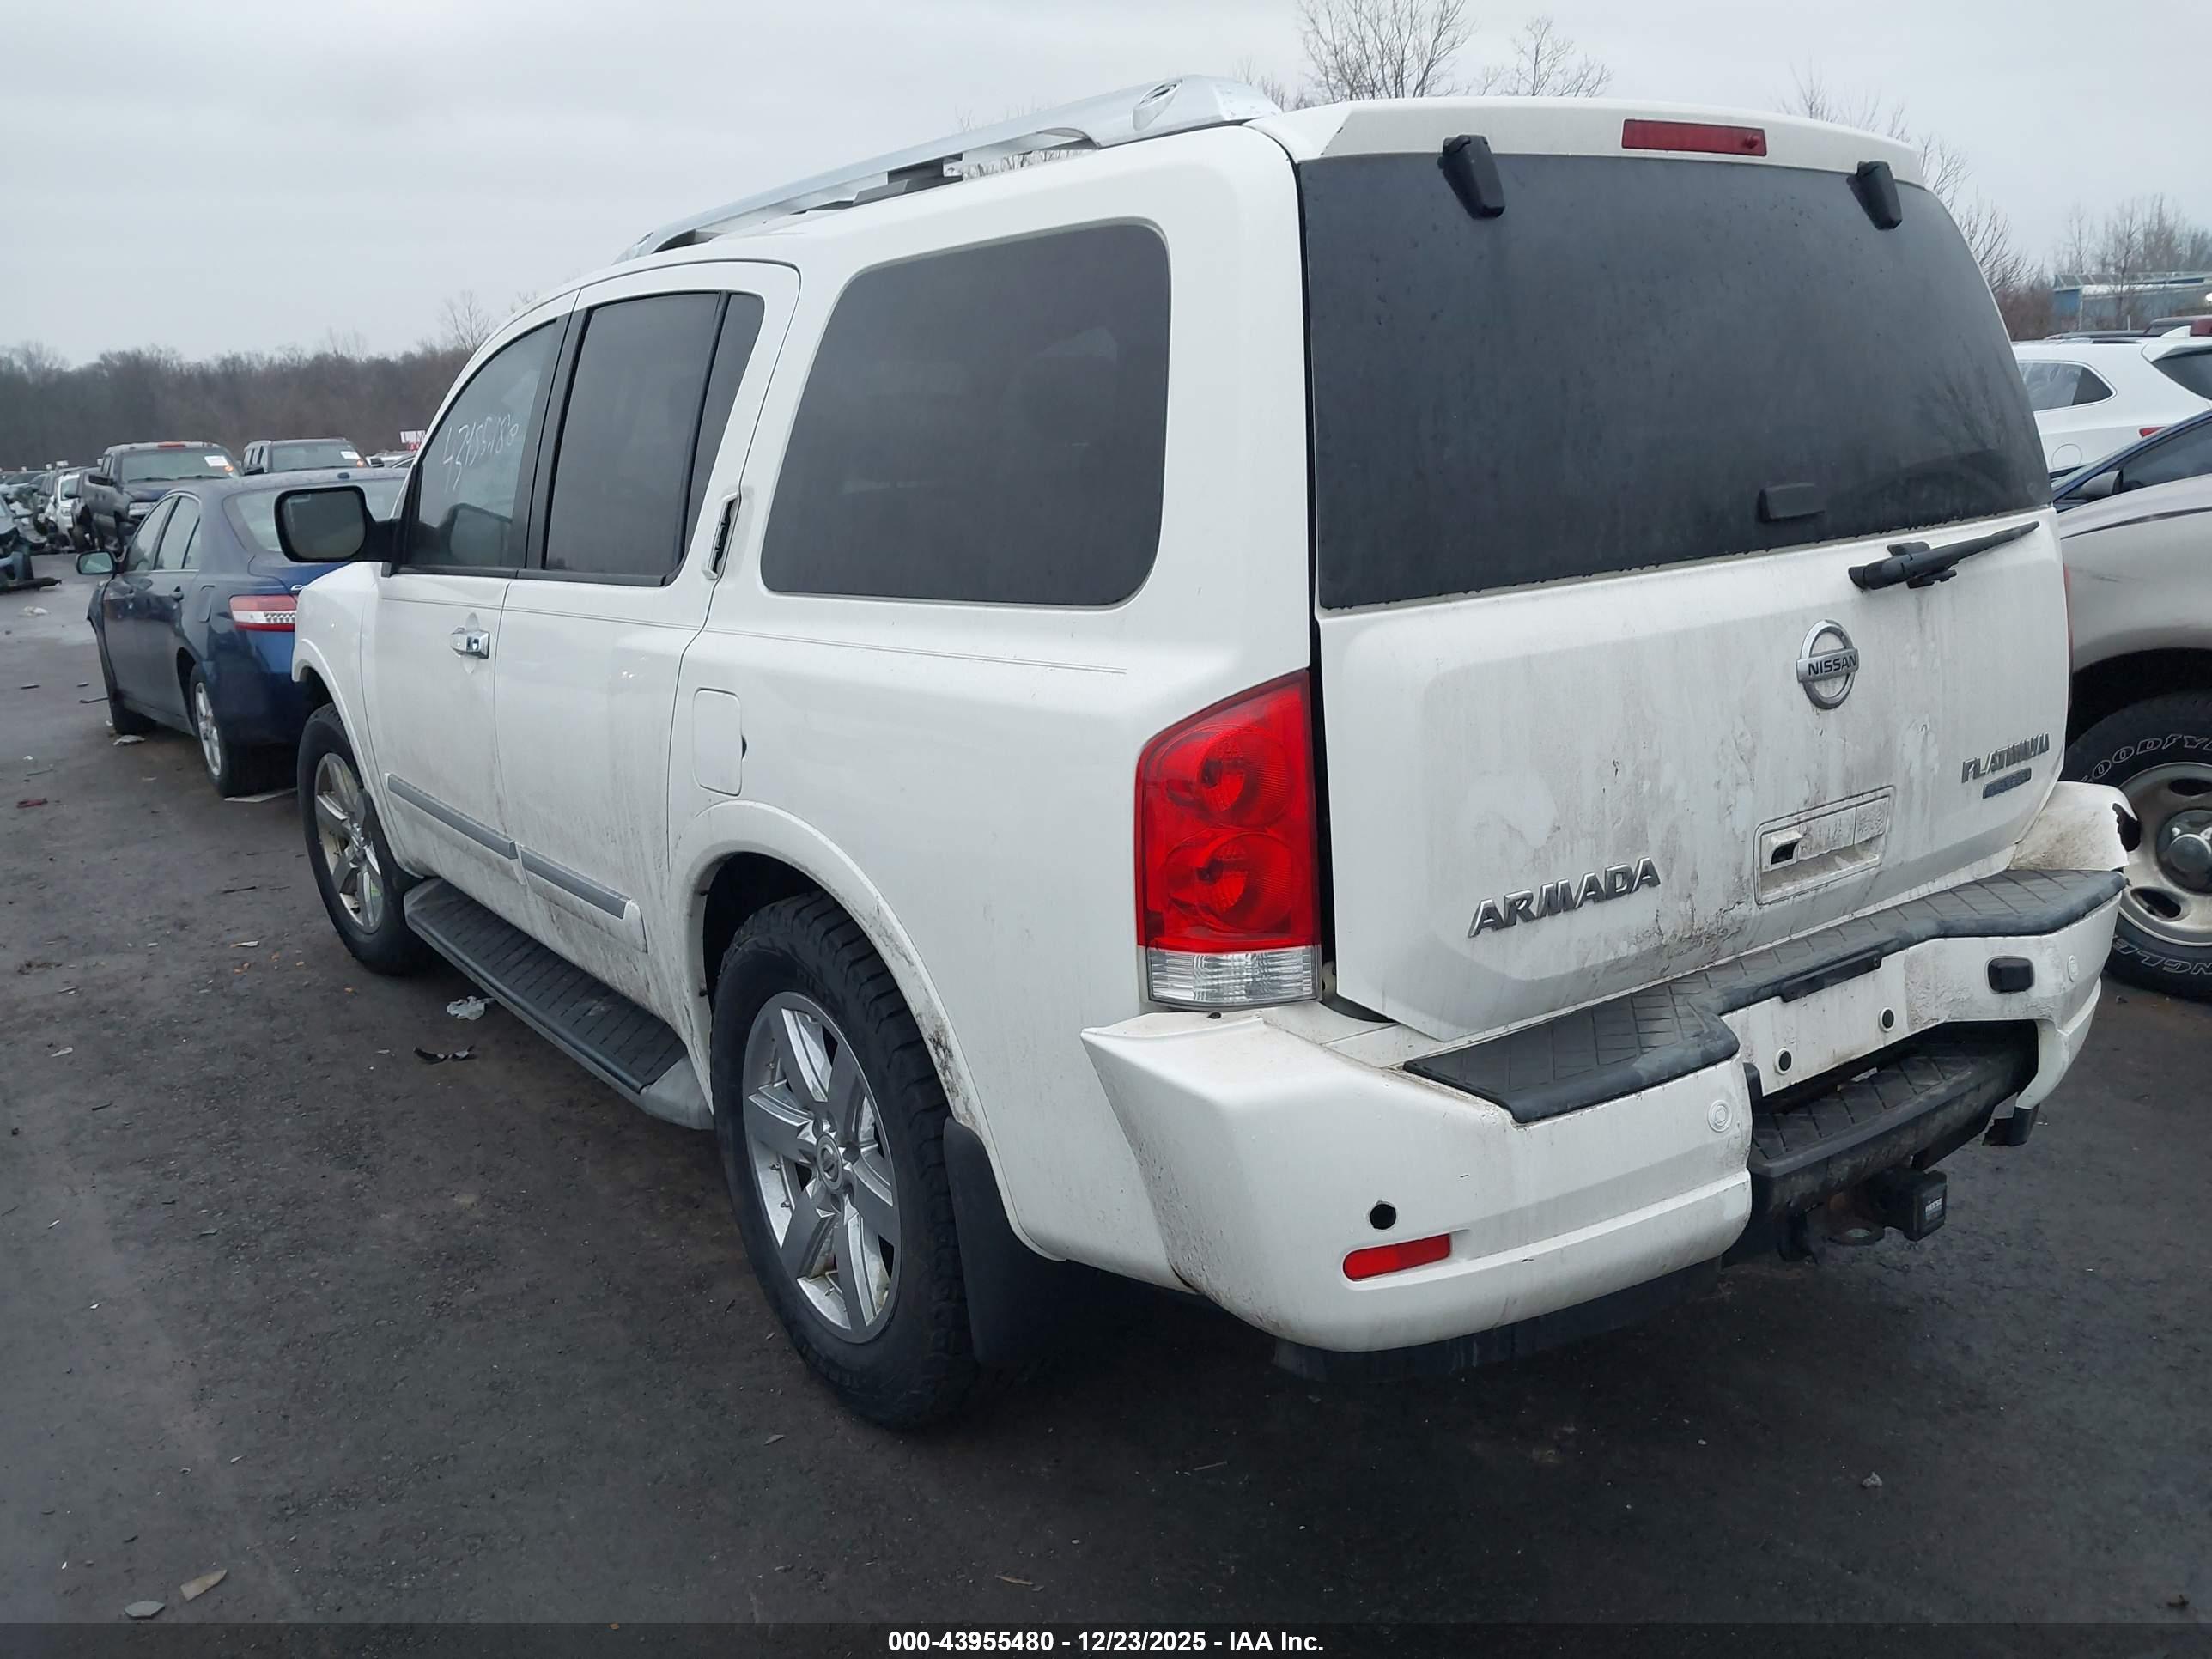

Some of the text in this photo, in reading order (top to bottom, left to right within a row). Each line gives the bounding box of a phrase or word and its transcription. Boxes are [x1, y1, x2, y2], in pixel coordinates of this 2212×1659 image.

[1808, 654, 1856, 677] NISSAN
[1961, 732, 2050, 784] PLATINUM
[1468, 857, 1661, 937] ARMADA
